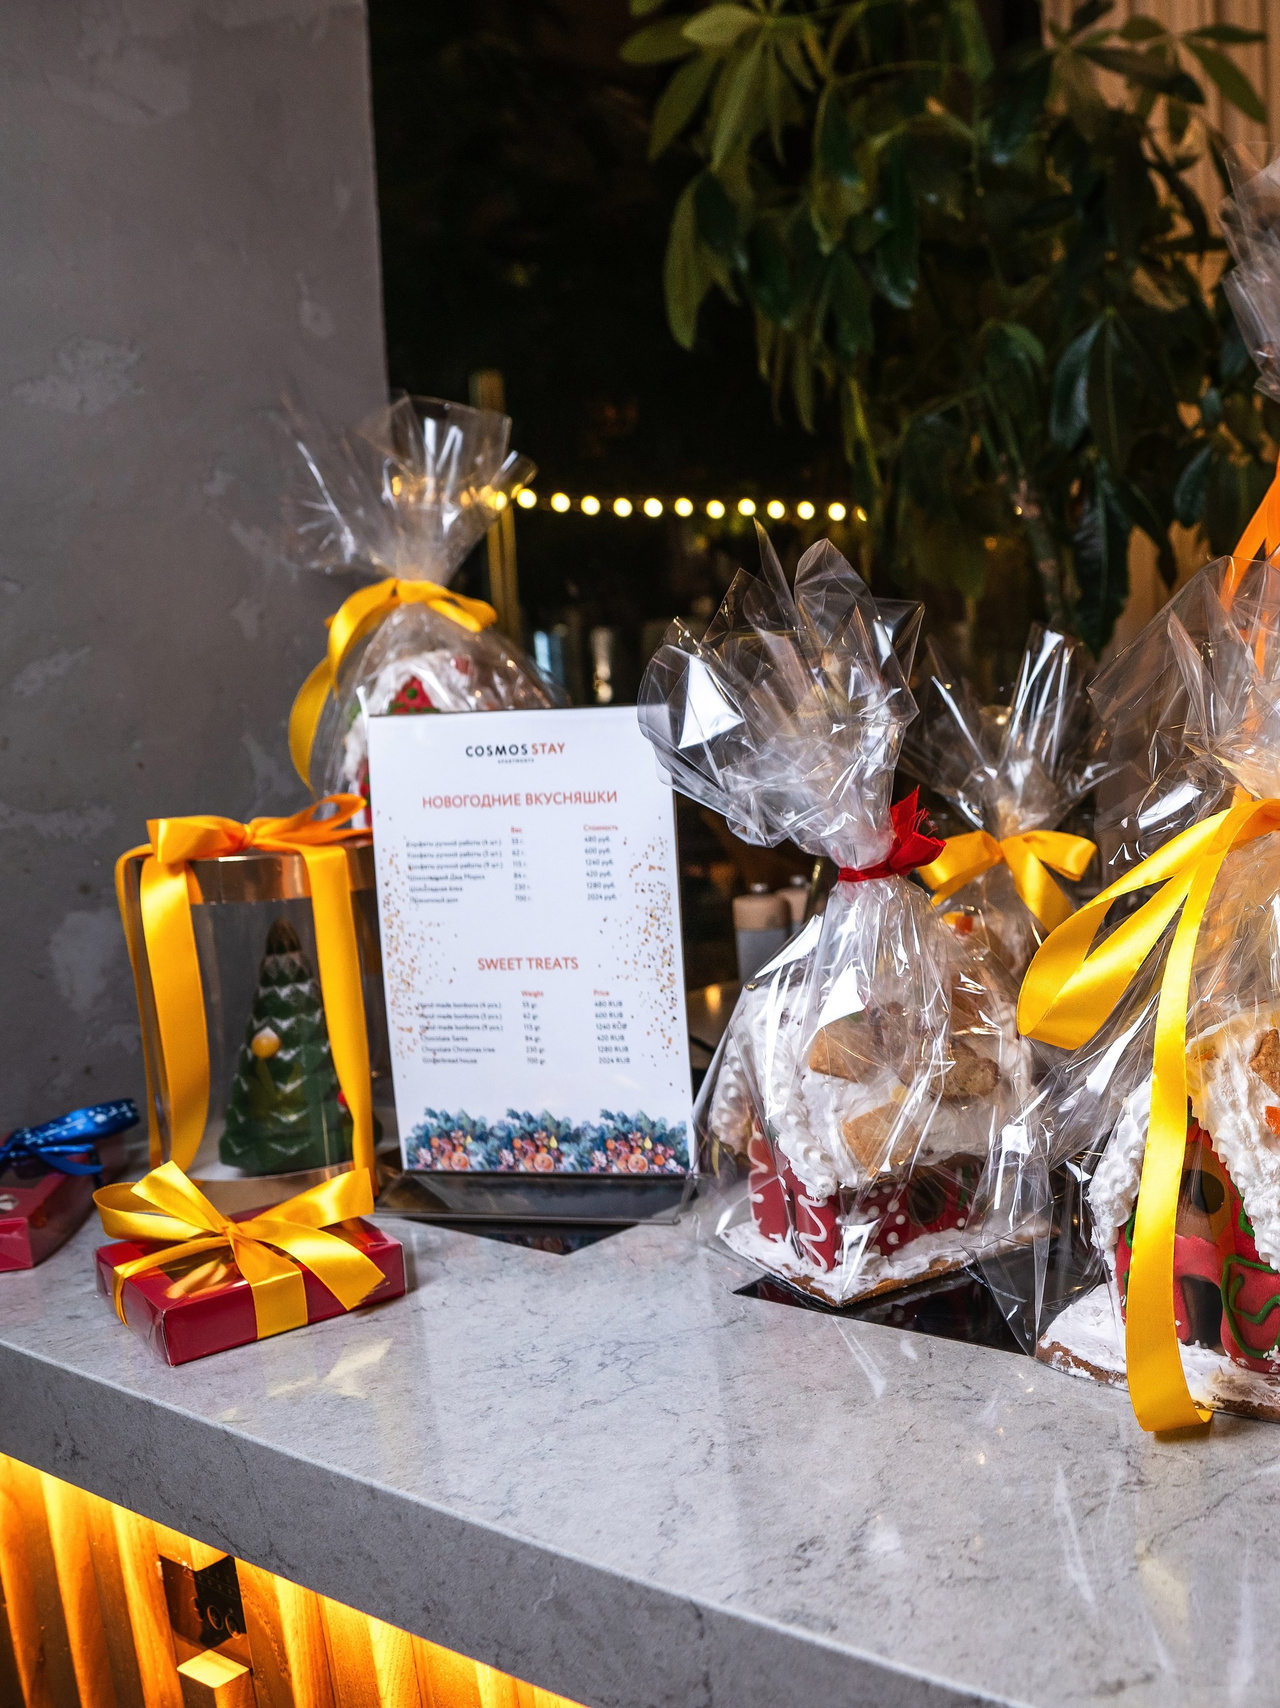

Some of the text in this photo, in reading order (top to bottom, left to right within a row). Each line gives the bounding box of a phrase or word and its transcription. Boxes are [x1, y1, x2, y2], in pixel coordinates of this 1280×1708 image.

[465, 742, 565, 757] COSMOS STAY
[422, 790, 617, 809] НОВОГОДНИЕ ВКУСНЯШКИ
[477, 957, 579, 971] SWEET TREATS
